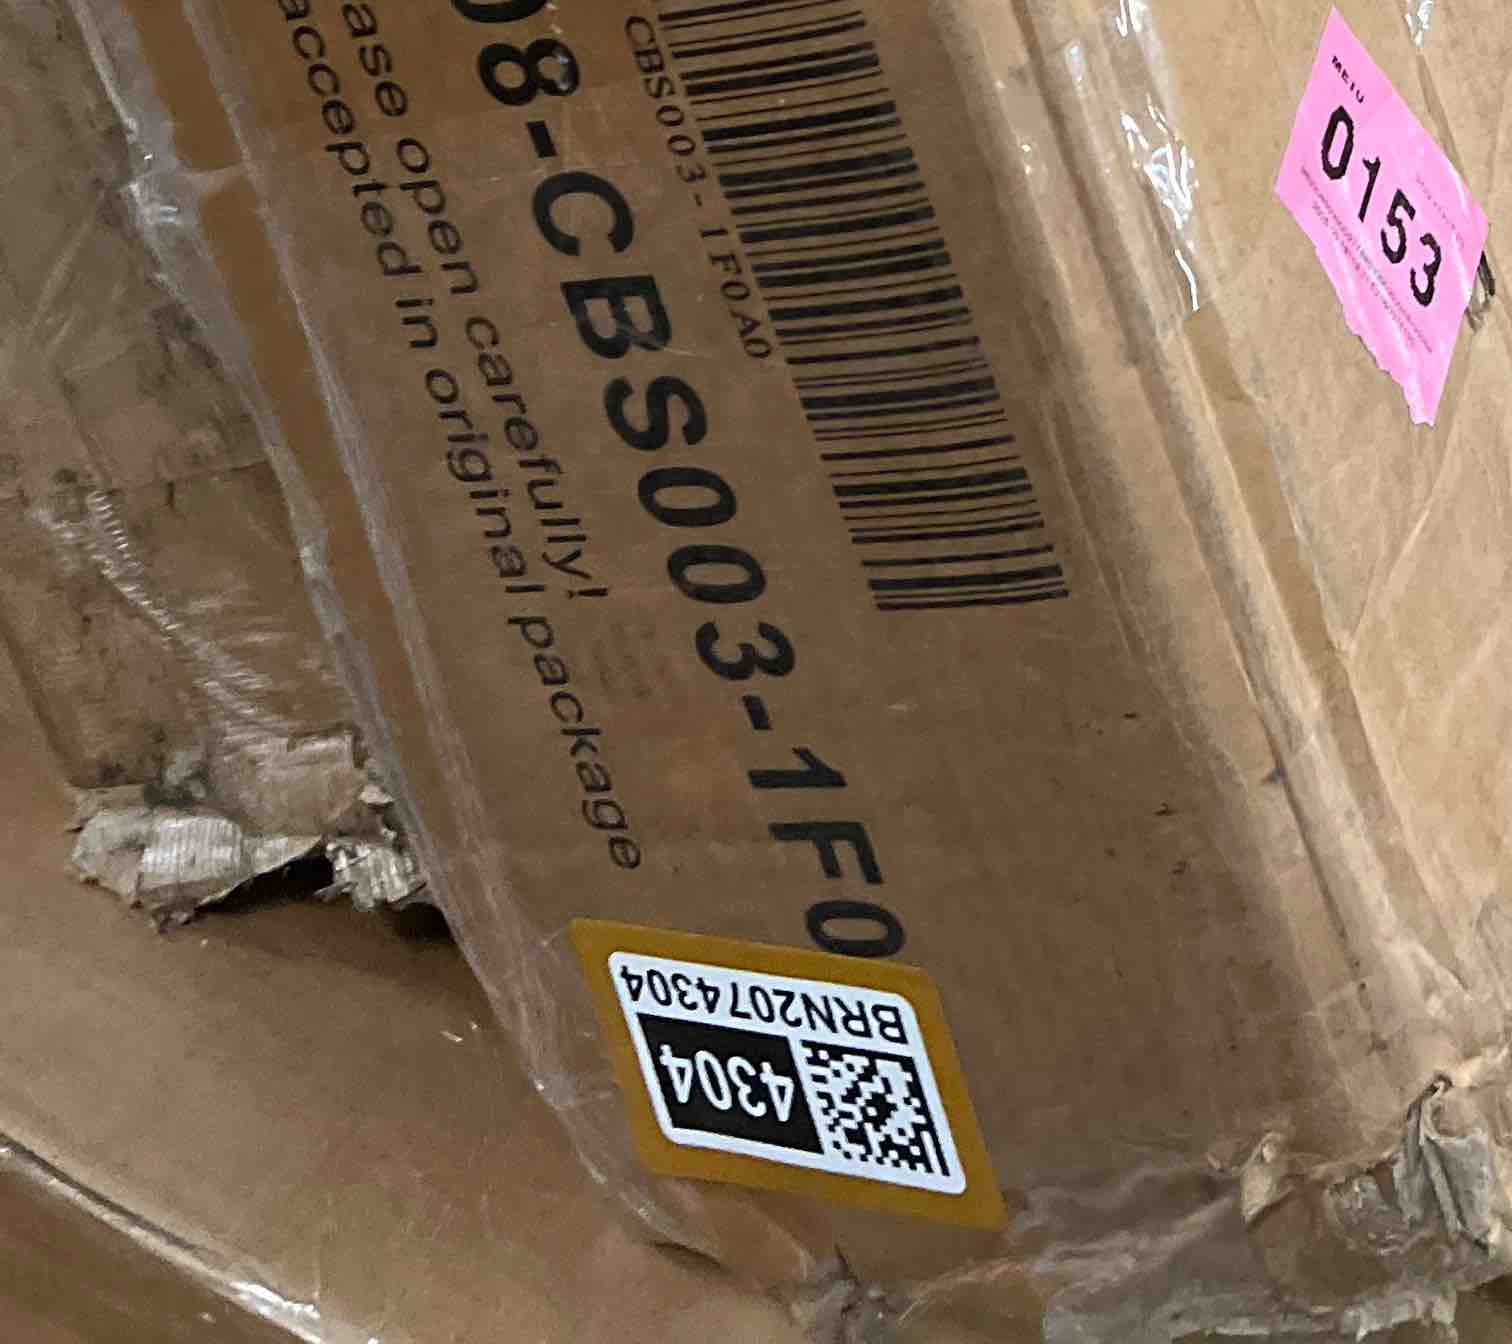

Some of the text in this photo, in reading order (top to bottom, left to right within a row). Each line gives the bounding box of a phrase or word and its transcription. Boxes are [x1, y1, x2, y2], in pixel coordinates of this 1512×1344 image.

[1320, 104, 1443, 308] 0153
[399, 137, 479, 299] open
[463, 316, 609, 602] carefully!
[395, 289, 440, 352] in
[423, 365, 530, 599] original
[506, 609, 643, 871] package
[620, 964, 909, 1046] BRN2074304
[658, 1042, 796, 1124] 4304
